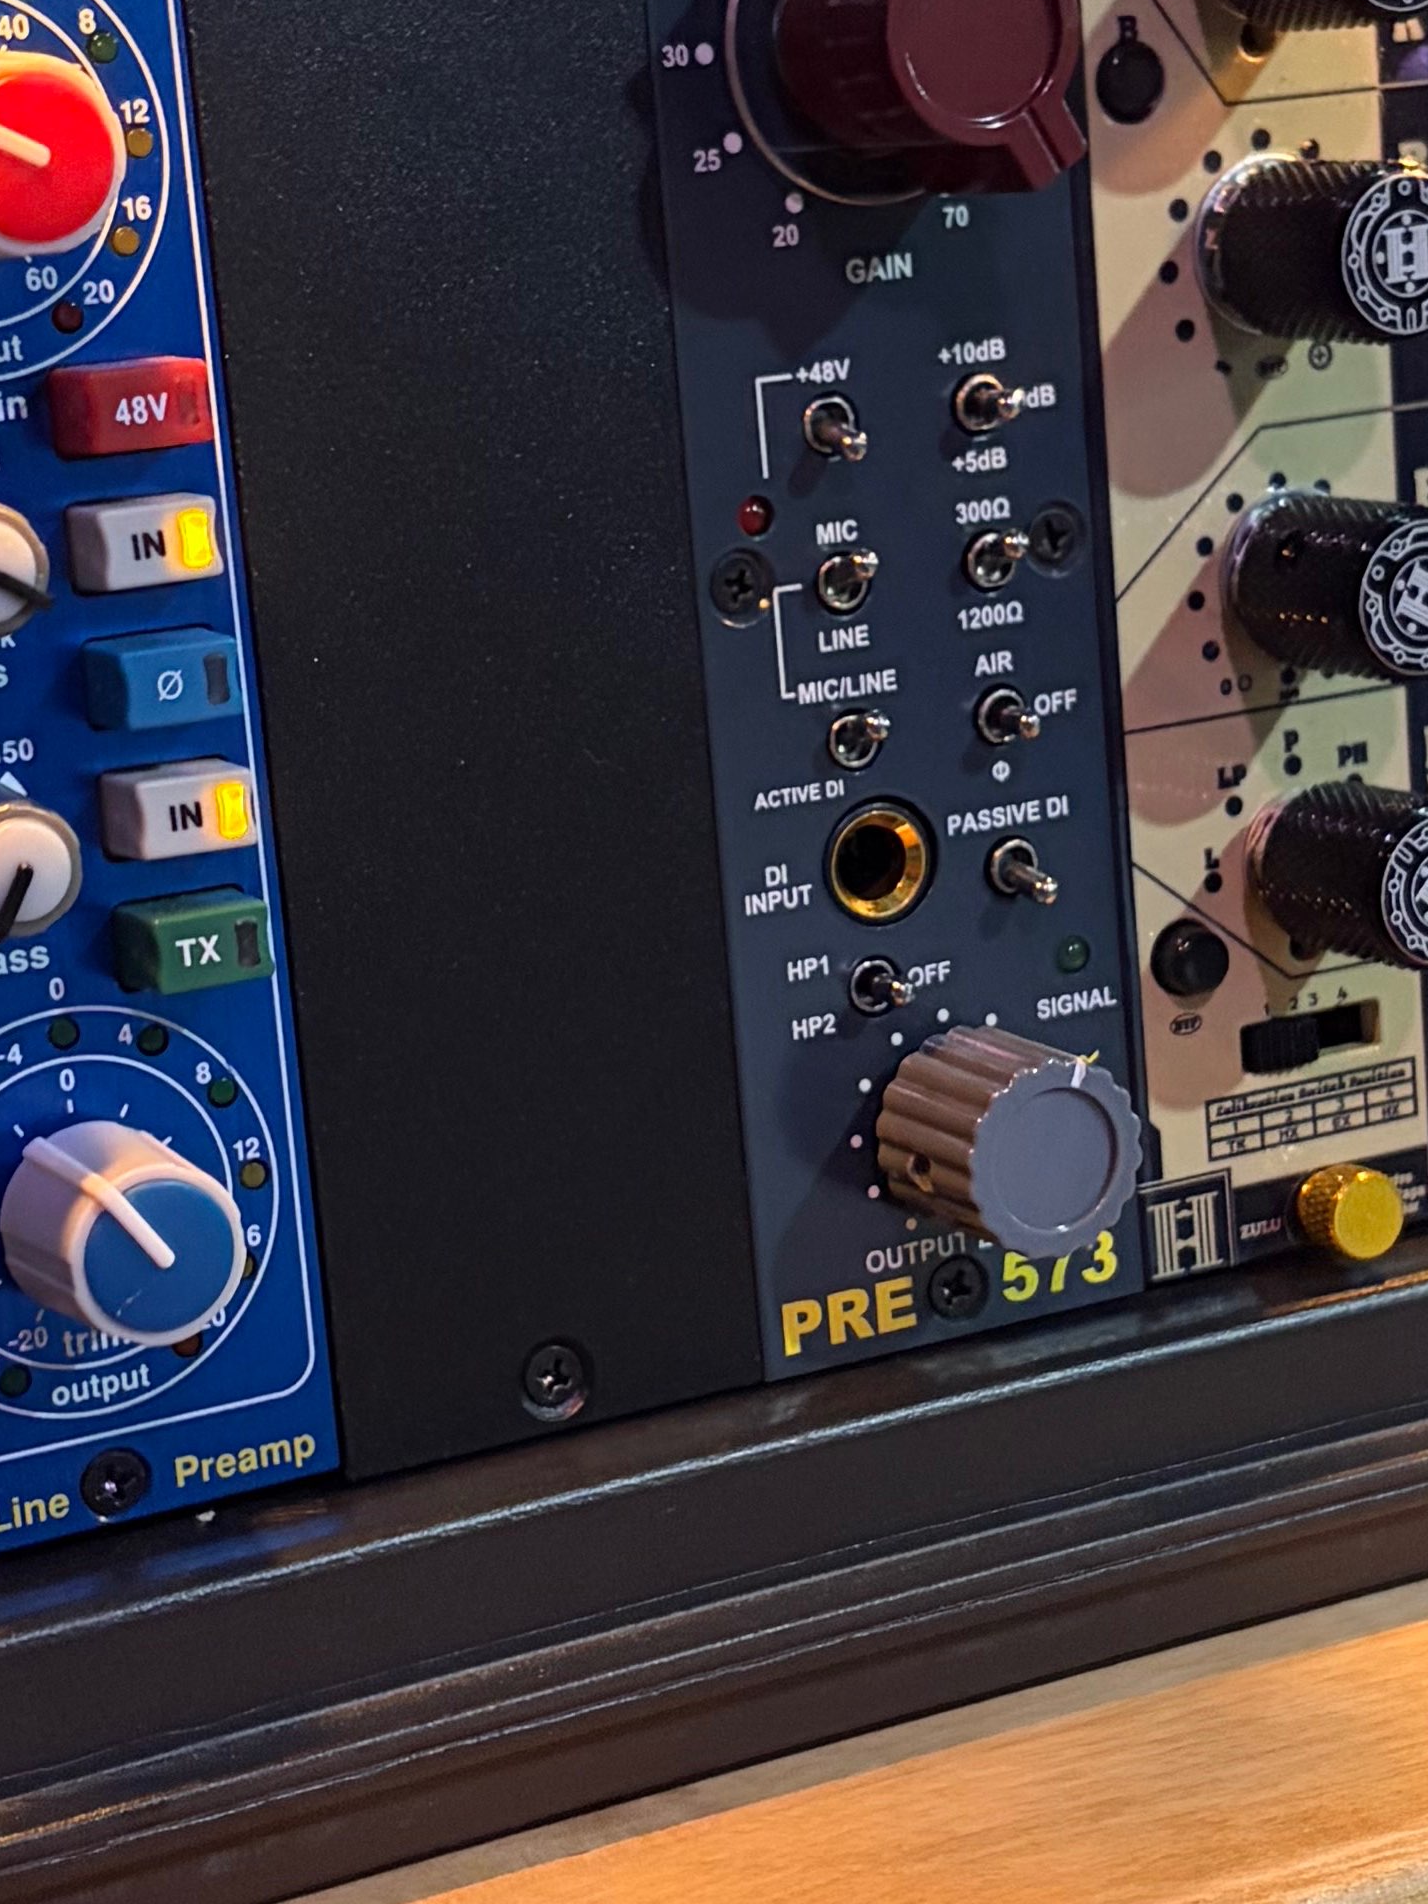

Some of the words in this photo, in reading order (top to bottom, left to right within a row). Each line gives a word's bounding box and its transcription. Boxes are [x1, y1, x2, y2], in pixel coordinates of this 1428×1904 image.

[662, 44, 689, 65] 30
[942, 206, 969, 228] 70
[845, 252, 913, 283] GAIN
[938, 338, 1005, 363] +10dB
[796, 359, 850, 384] +48V
[115, 393, 168, 426] 48V
[952, 449, 1007, 473] +5dB
[955, 498, 1011, 524] 300Ω
[132, 529, 166, 561] IN
[816, 520, 858, 543] MIC
[958, 602, 1024, 630] 1200Ω
[819, 626, 870, 652] LINE
[975, 652, 1013, 676] AIR
[797, 669, 898, 705] MIC/LINE
[1034, 690, 1077, 715] OFF
[754, 785, 821, 811] ACTIVE
[826, 779, 845, 798] DI
[169, 800, 203, 831] IN
[947, 802, 1041, 835] PASSIVE
[1047, 796, 1068, 818] DI
[765, 865, 788, 887] DI
[744, 885, 812, 915] INPUT
[175, 935, 221, 965] TX
[787, 956, 830, 981] HP1
[908, 961, 951, 988] OFF
[1036, 987, 1117, 1019] SIGNAL
[792, 1013, 836, 1040] HP2
[865, 1233, 967, 1274] OUTPUT
[782, 1276, 917, 1357] PRE
[50, 1363, 151, 1407] output
[174, 1431, 316, 1488] Preamp
